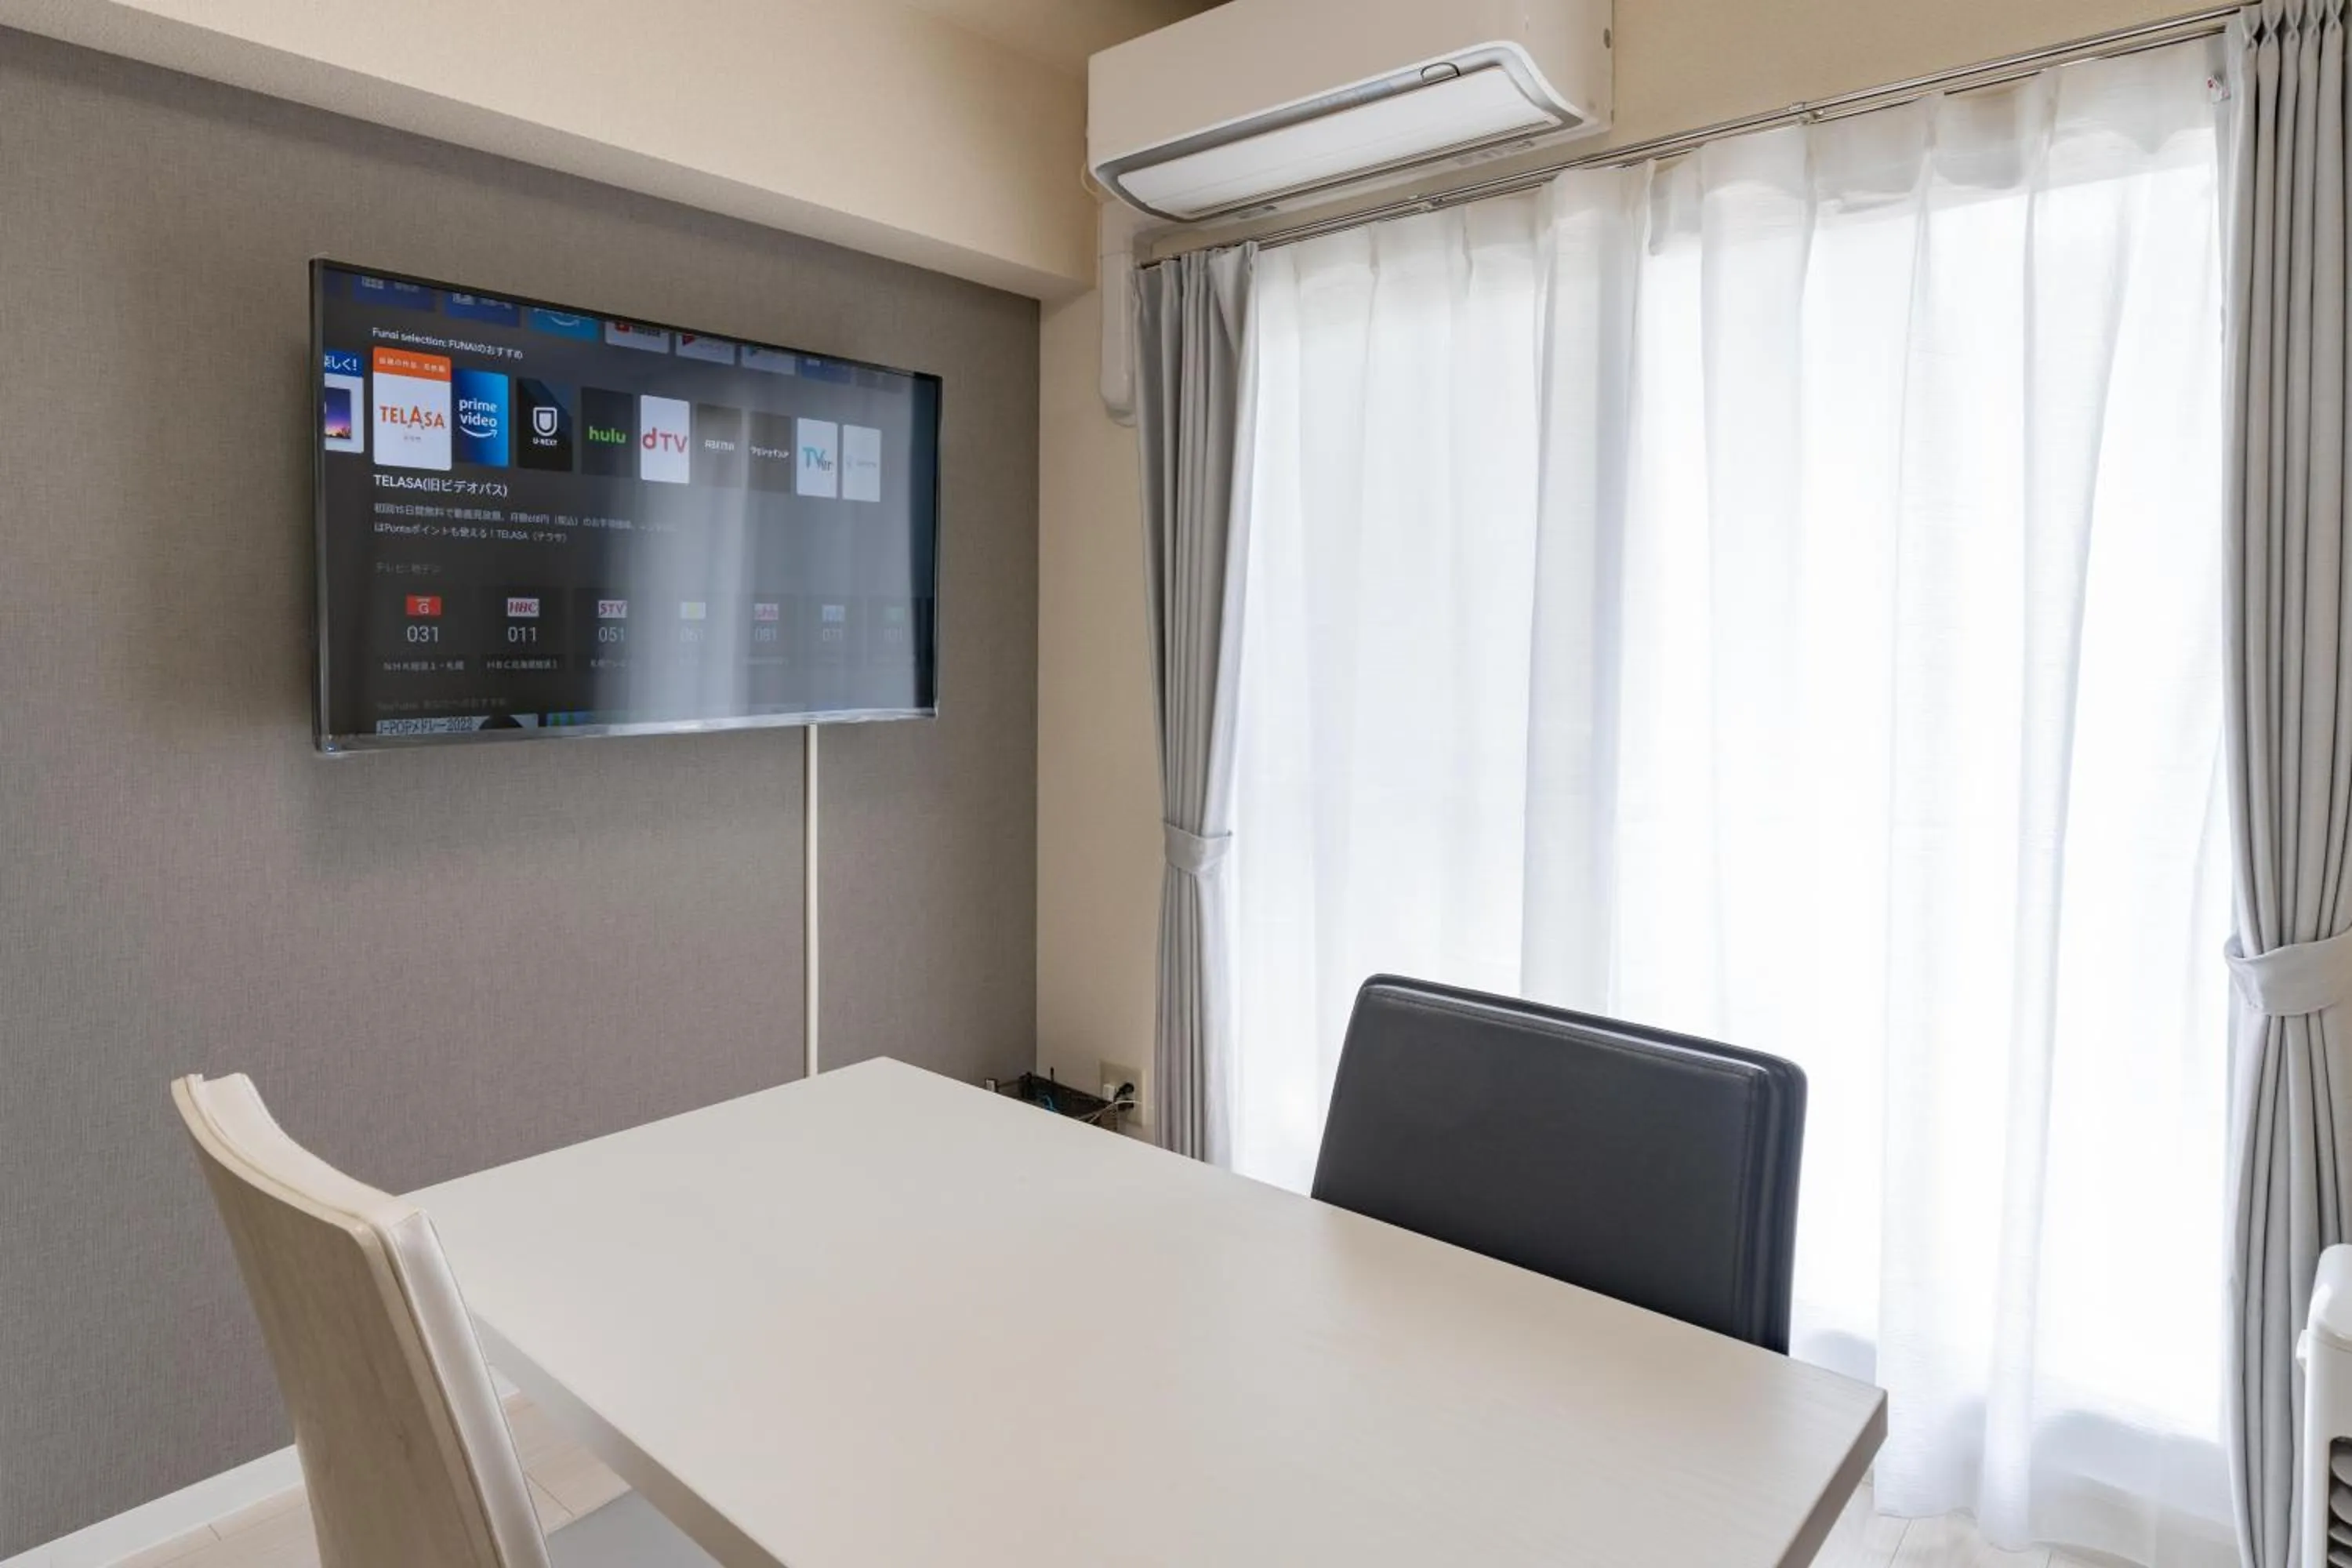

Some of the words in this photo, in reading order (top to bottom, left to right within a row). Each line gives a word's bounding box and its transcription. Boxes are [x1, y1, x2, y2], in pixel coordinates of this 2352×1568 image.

[372, 327, 399, 339] Funai
[459, 398, 498, 412] prime
[379, 405, 446, 430] TELASA
[459, 412, 498, 426] video
[589, 426, 626, 444] hulu
[642, 426, 688, 453] dTV
[600, 603, 626, 615] STV
[406, 626, 439, 642] 031
[507, 626, 536, 642] 011
